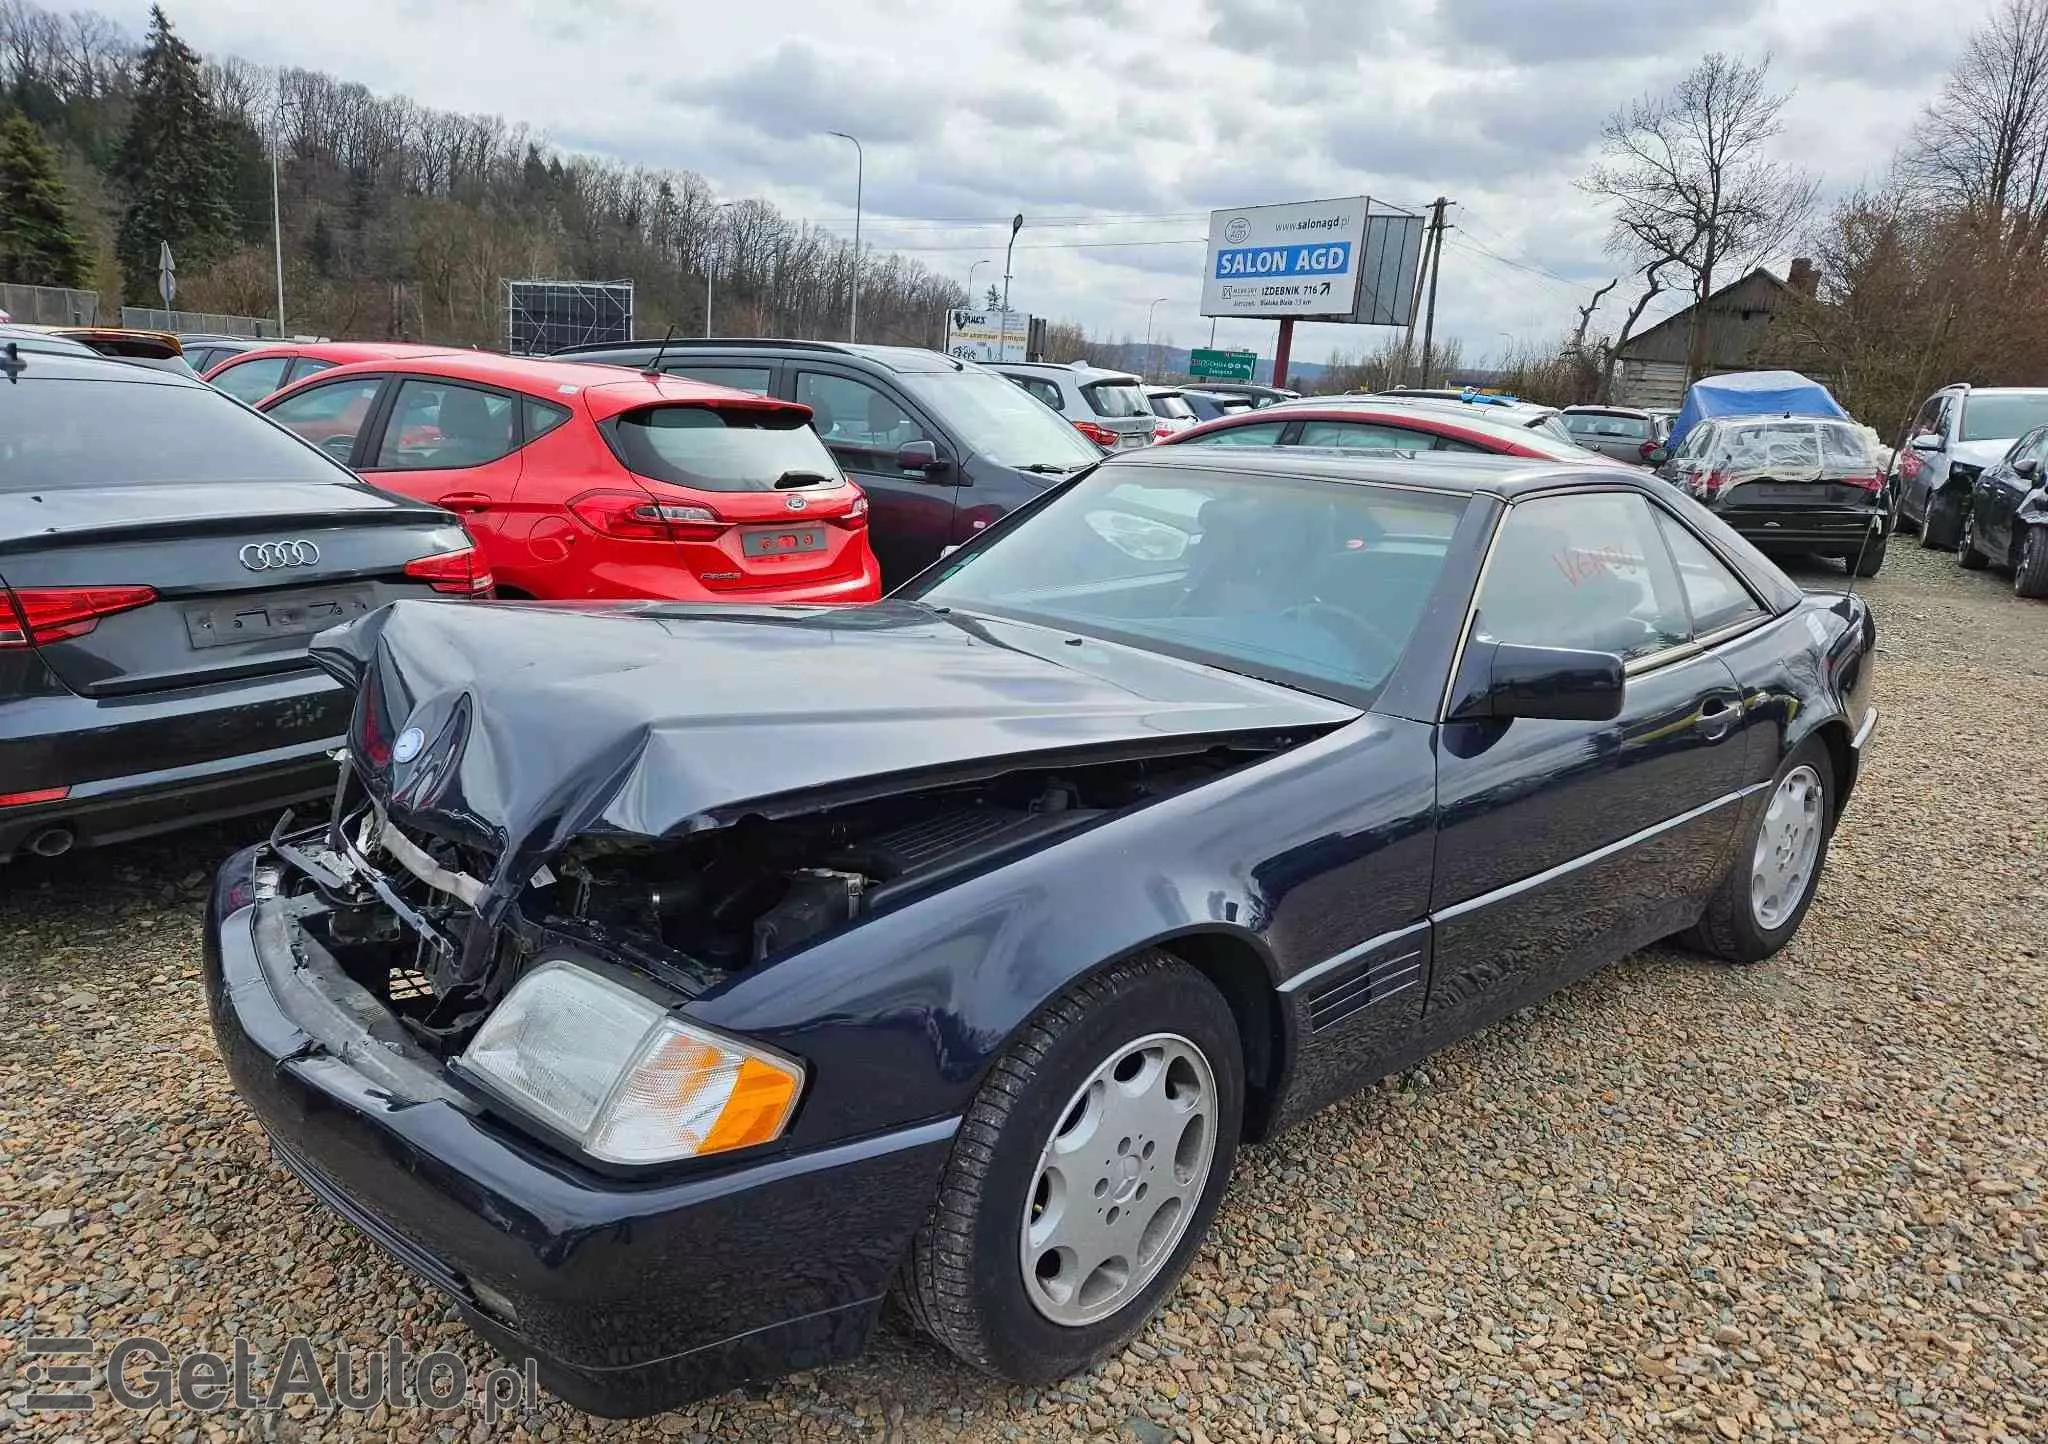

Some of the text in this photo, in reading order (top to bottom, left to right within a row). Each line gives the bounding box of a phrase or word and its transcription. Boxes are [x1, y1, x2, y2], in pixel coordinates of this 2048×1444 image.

[1275, 215, 1351, 233] www.salonagd.pl
[1220, 247, 1345, 274] SALON AGD
[1261, 285, 1318, 296] IZDEBNIK 716
